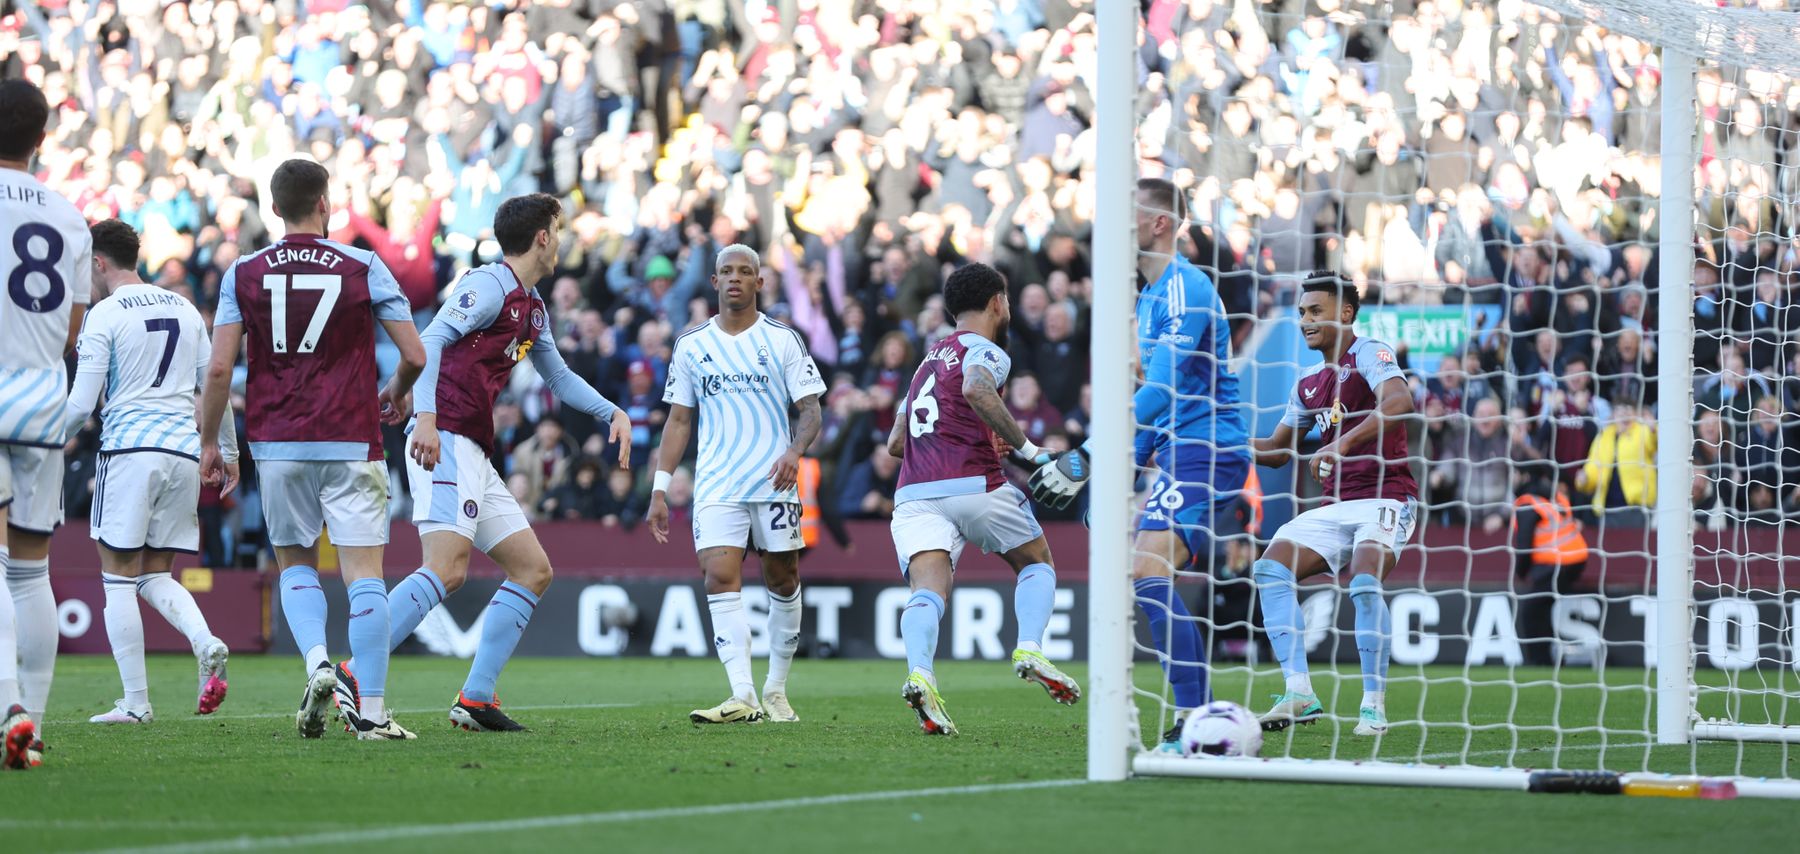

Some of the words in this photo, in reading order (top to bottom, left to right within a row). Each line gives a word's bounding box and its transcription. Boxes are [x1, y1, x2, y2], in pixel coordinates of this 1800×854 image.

[8, 222, 65, 314] 8
[265, 248, 343, 269] LENGLET
[263, 274, 342, 353] 17
[1403, 318, 1462, 349] EXIT
[144, 318, 180, 387] 7
[910, 371, 939, 438] 6
[769, 502, 798, 530] 28
[1147, 481, 1184, 510] 26
[1391, 592, 1800, 670] CASTO
